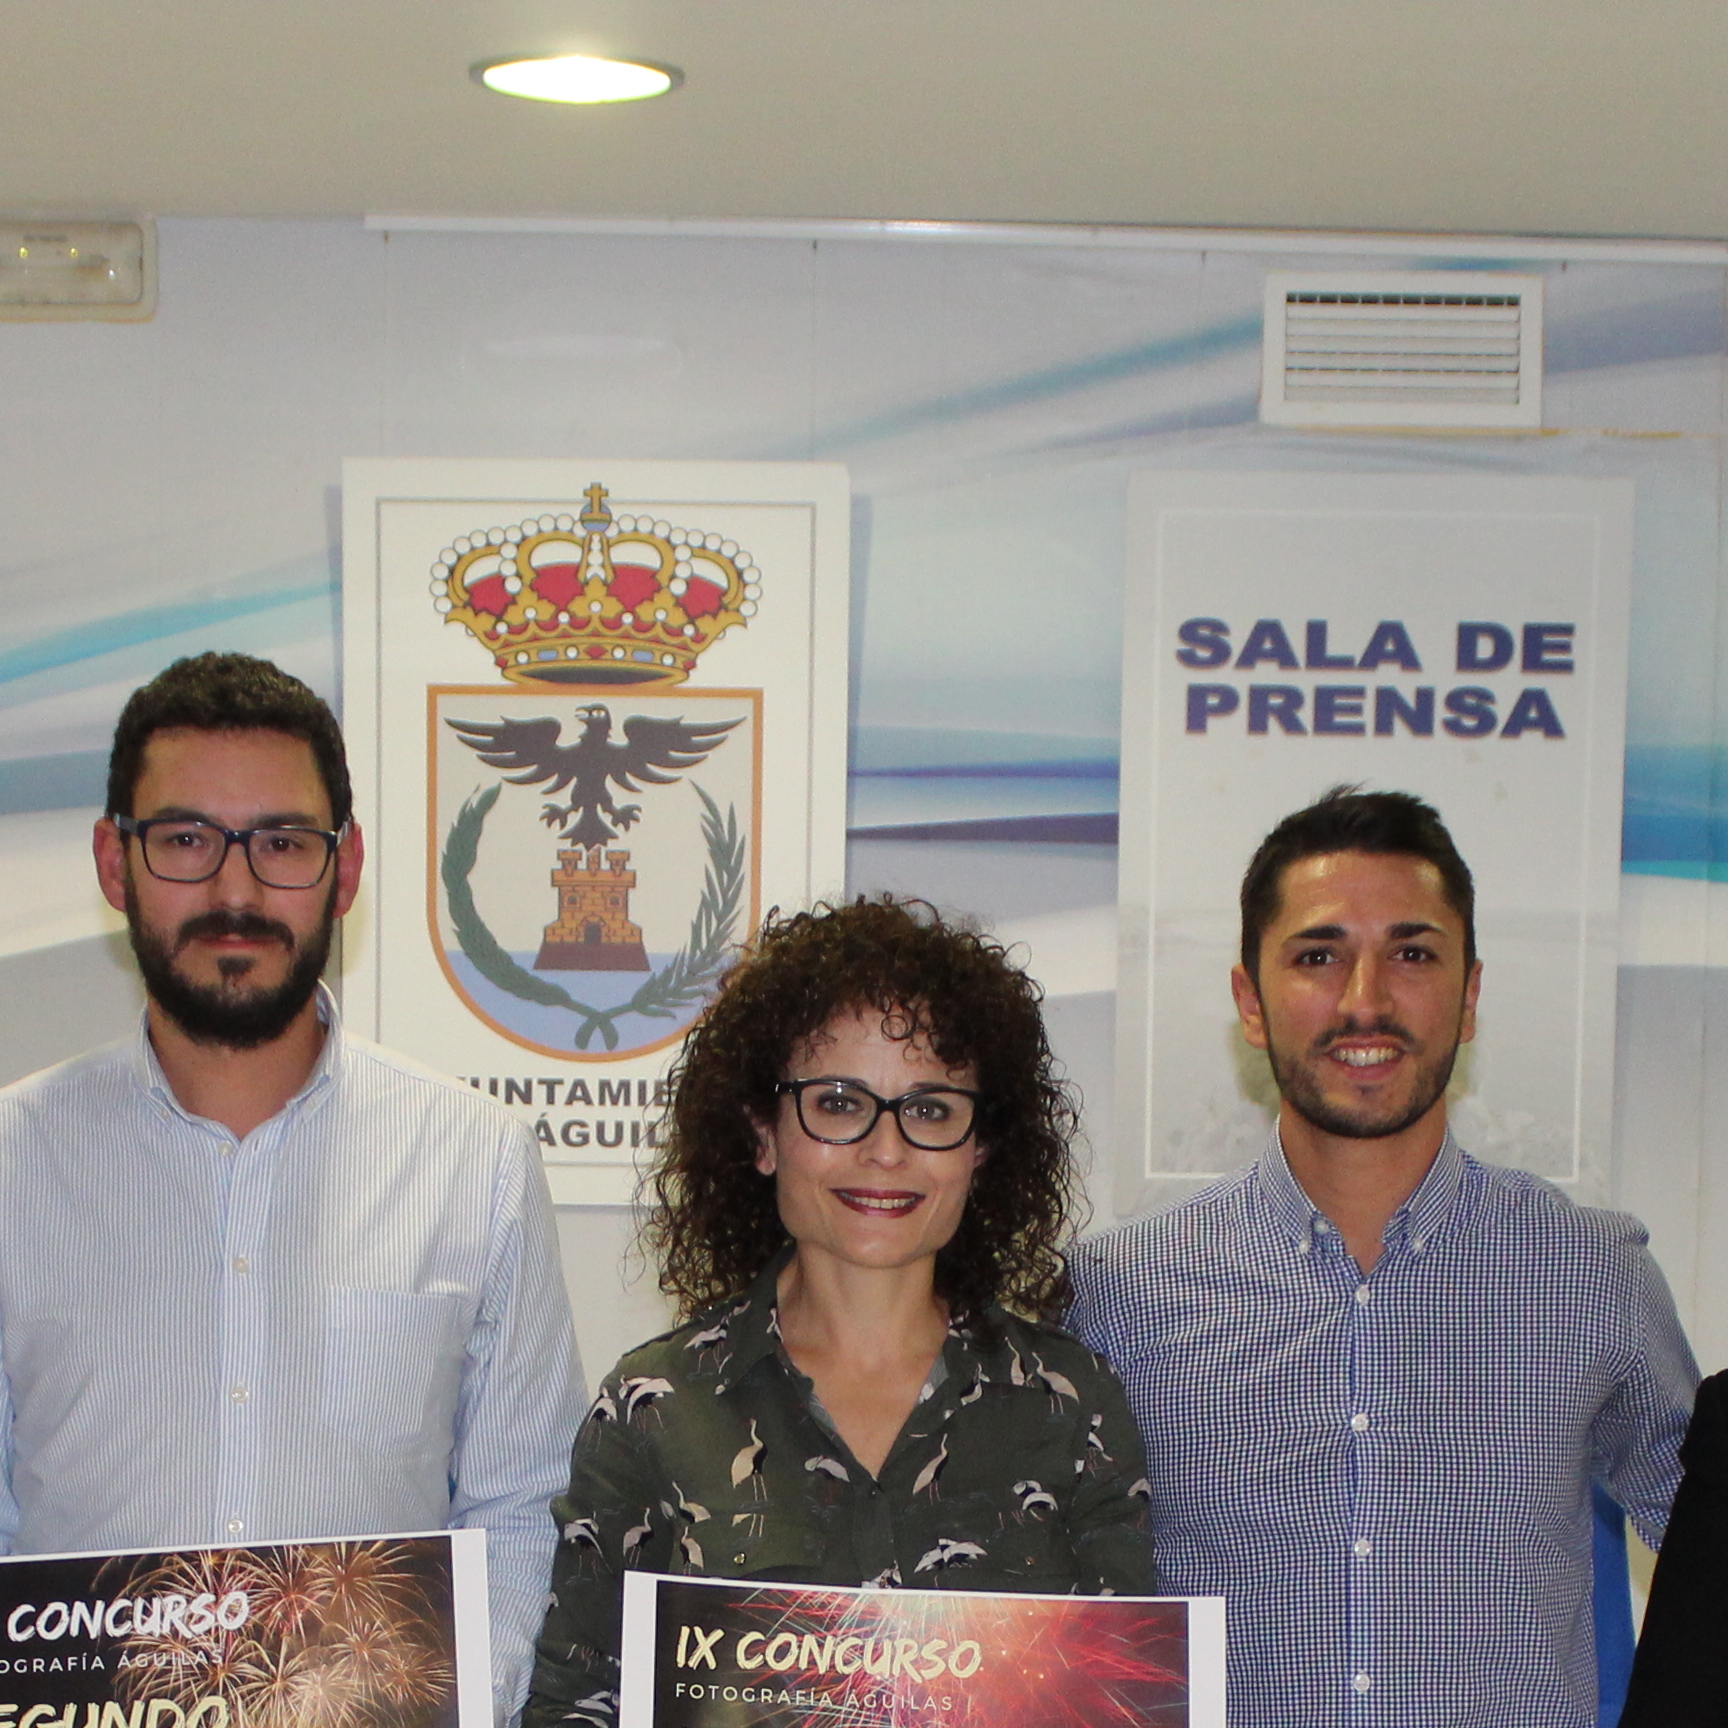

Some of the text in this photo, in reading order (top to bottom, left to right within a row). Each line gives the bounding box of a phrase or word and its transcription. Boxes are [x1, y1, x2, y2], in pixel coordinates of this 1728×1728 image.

[1176, 616, 1577, 675] SALA DE
[1185, 682, 1566, 740] PRENSA
[535, 1112, 670, 1149] ÁGUIL
[7, 1590, 251, 1642] CONCURSO
[117, 1649, 224, 1670] ÁGUILAS
[675, 1625, 983, 1683] IX CONCURSO
[675, 1682, 954, 1711] FOTOGRAFÍA ÁGUILAS
